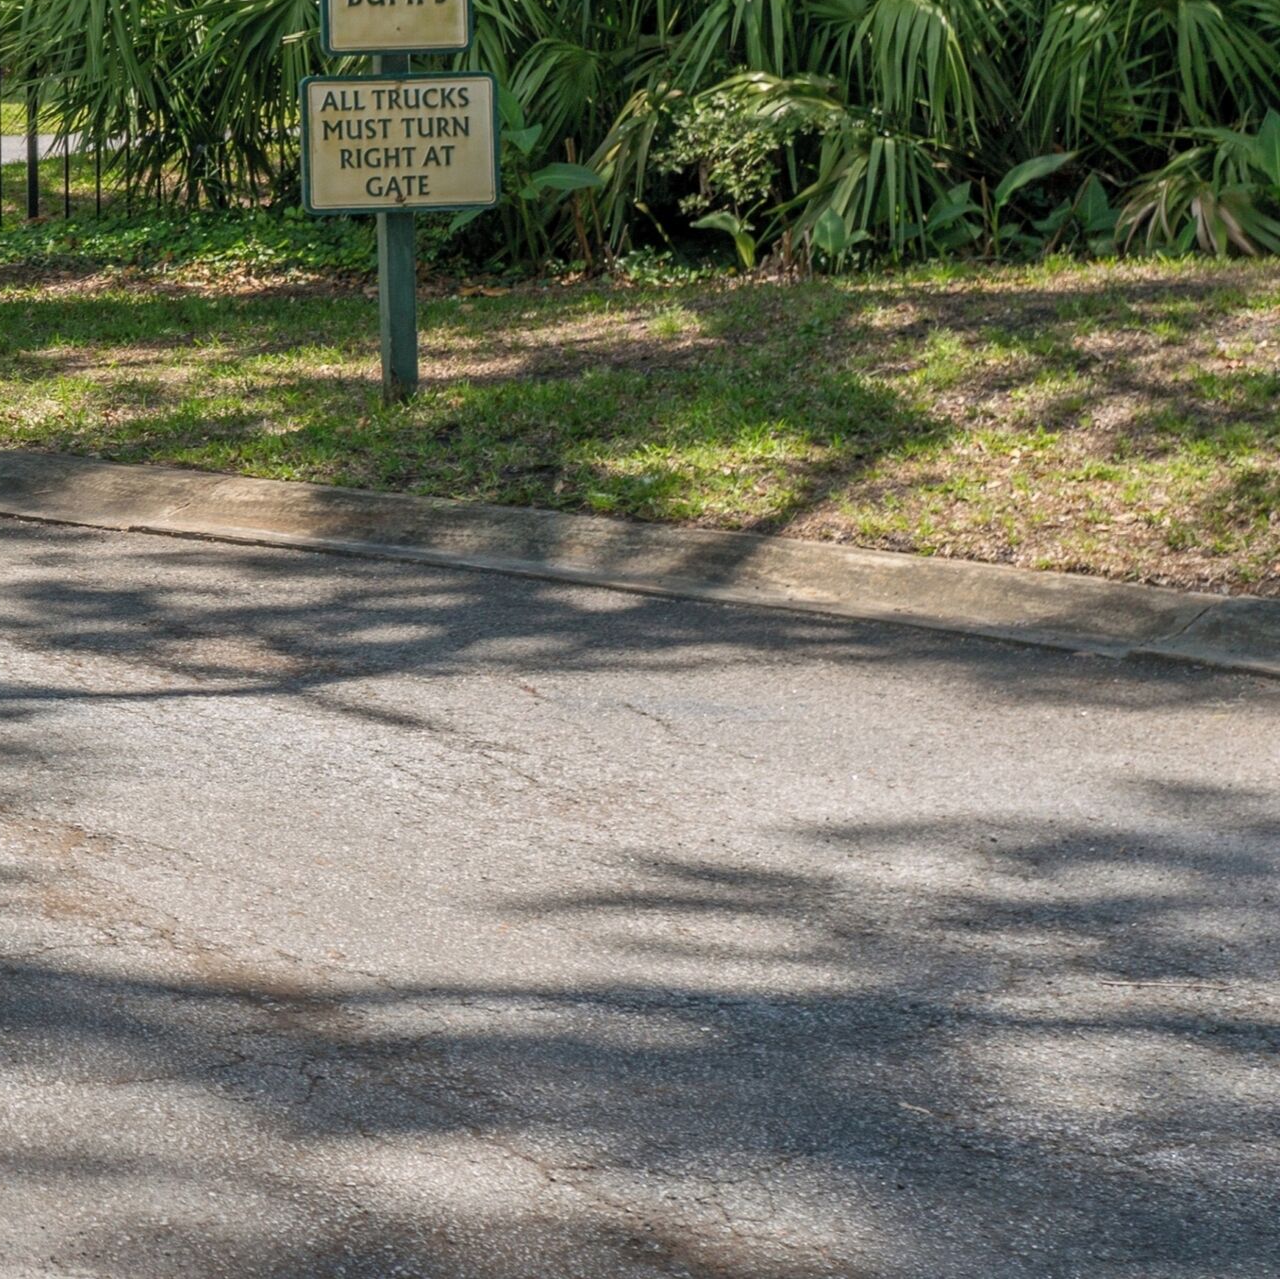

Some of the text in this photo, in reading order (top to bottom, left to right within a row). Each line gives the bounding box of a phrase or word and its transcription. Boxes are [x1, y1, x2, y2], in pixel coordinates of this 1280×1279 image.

[321, 87, 469, 112] ALL TRUCKS
[323, 116, 470, 141] MUST TURN
[340, 145, 455, 169] RIGHT AT
[366, 175, 430, 197] GATE
